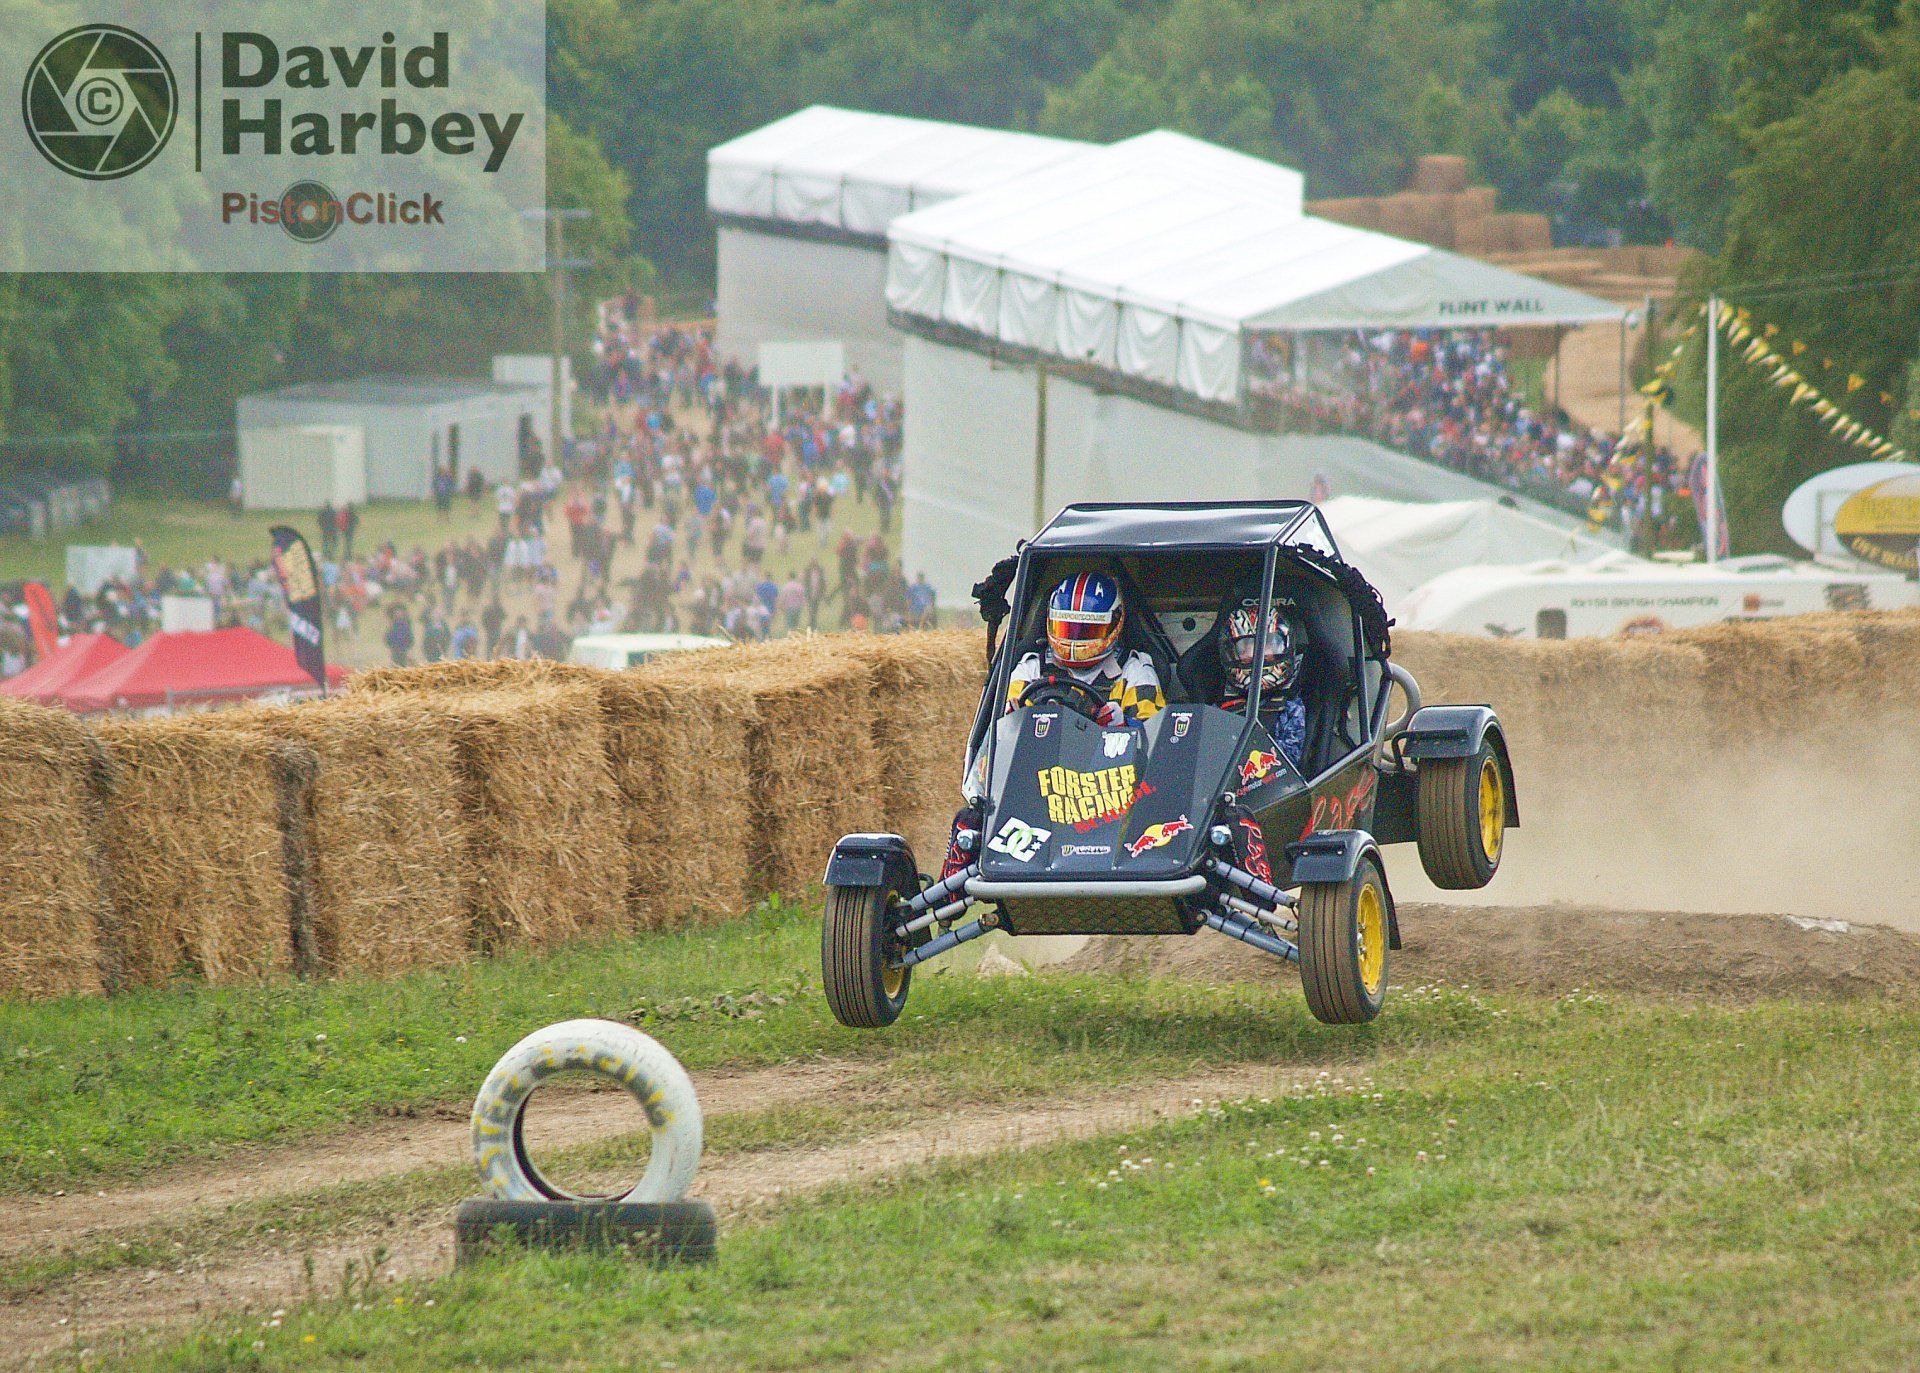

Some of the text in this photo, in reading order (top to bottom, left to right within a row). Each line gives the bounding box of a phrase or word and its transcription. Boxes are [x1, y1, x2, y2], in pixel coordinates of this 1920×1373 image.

[1439, 298, 1544, 315] FLINT WALL
[1657, 595, 1720, 607] CHAMPION
[1038, 765, 1136, 800] FORSTER
[1048, 786, 1134, 825] RACING
